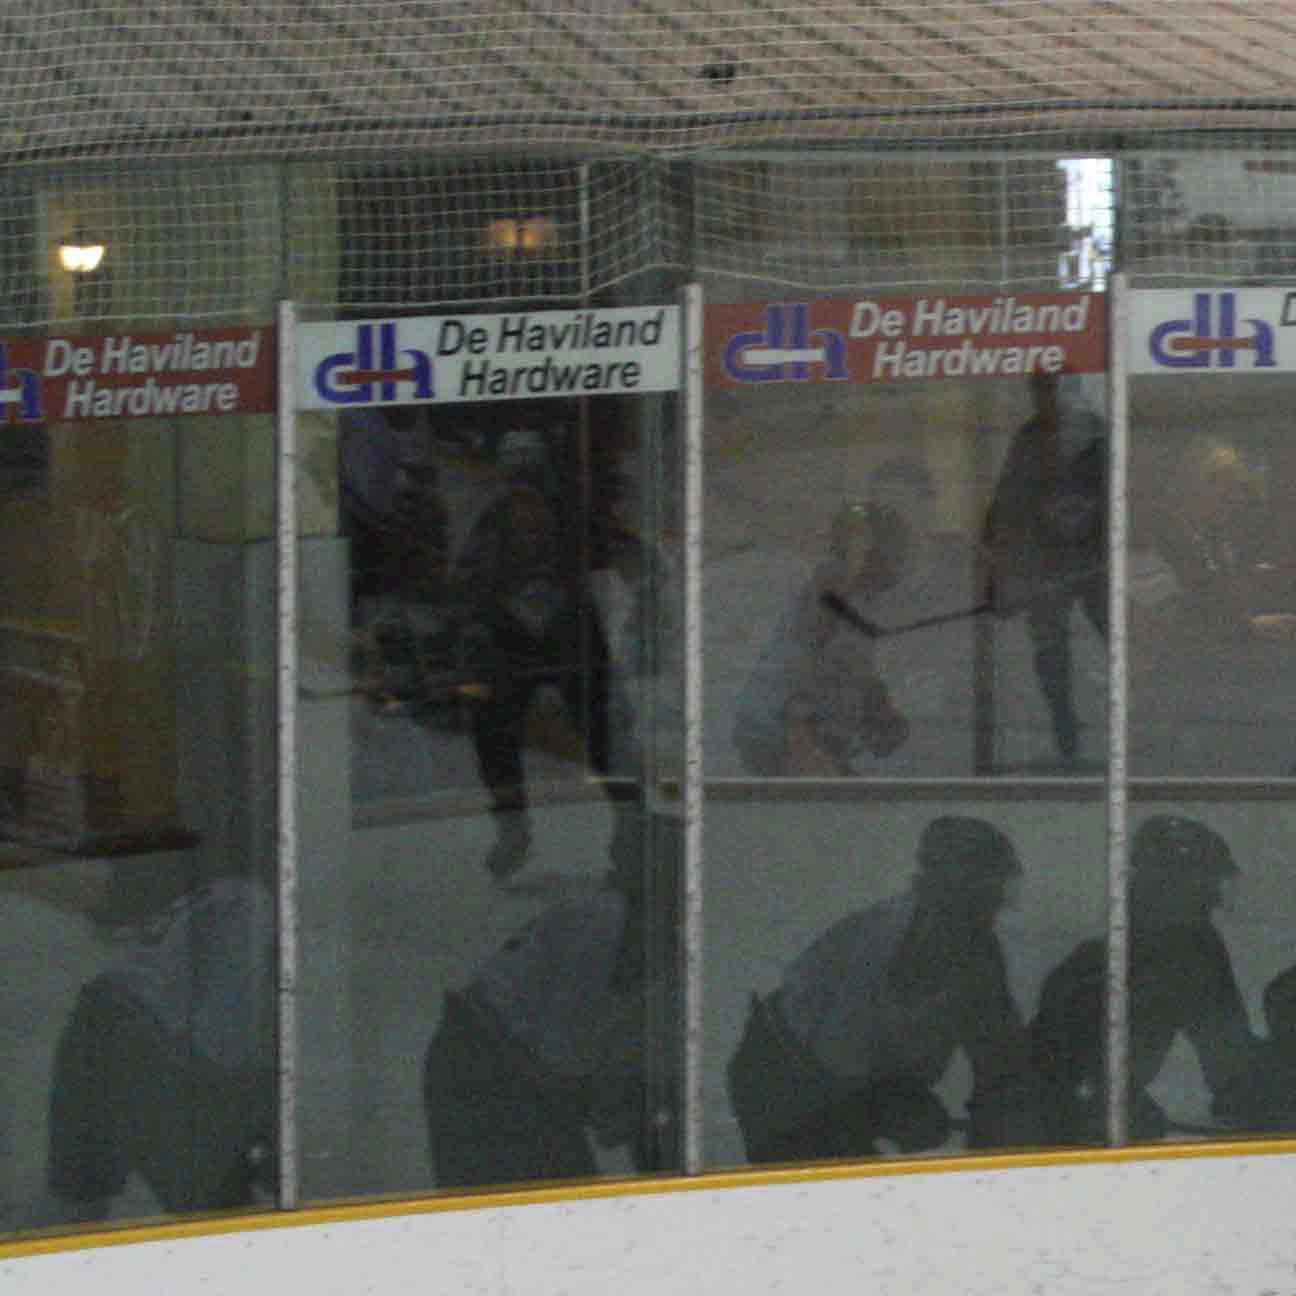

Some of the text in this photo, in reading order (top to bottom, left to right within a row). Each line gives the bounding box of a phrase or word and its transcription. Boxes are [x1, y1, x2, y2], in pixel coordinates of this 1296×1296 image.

[436, 312, 662, 355] De Haviland
[849, 299, 1089, 338] De Haviland
[44, 332, 259, 376] De Haviland
[871, 341, 1064, 378] Hardware
[458, 359, 641, 398] Hardware
[64, 380, 239, 418] Hardware
